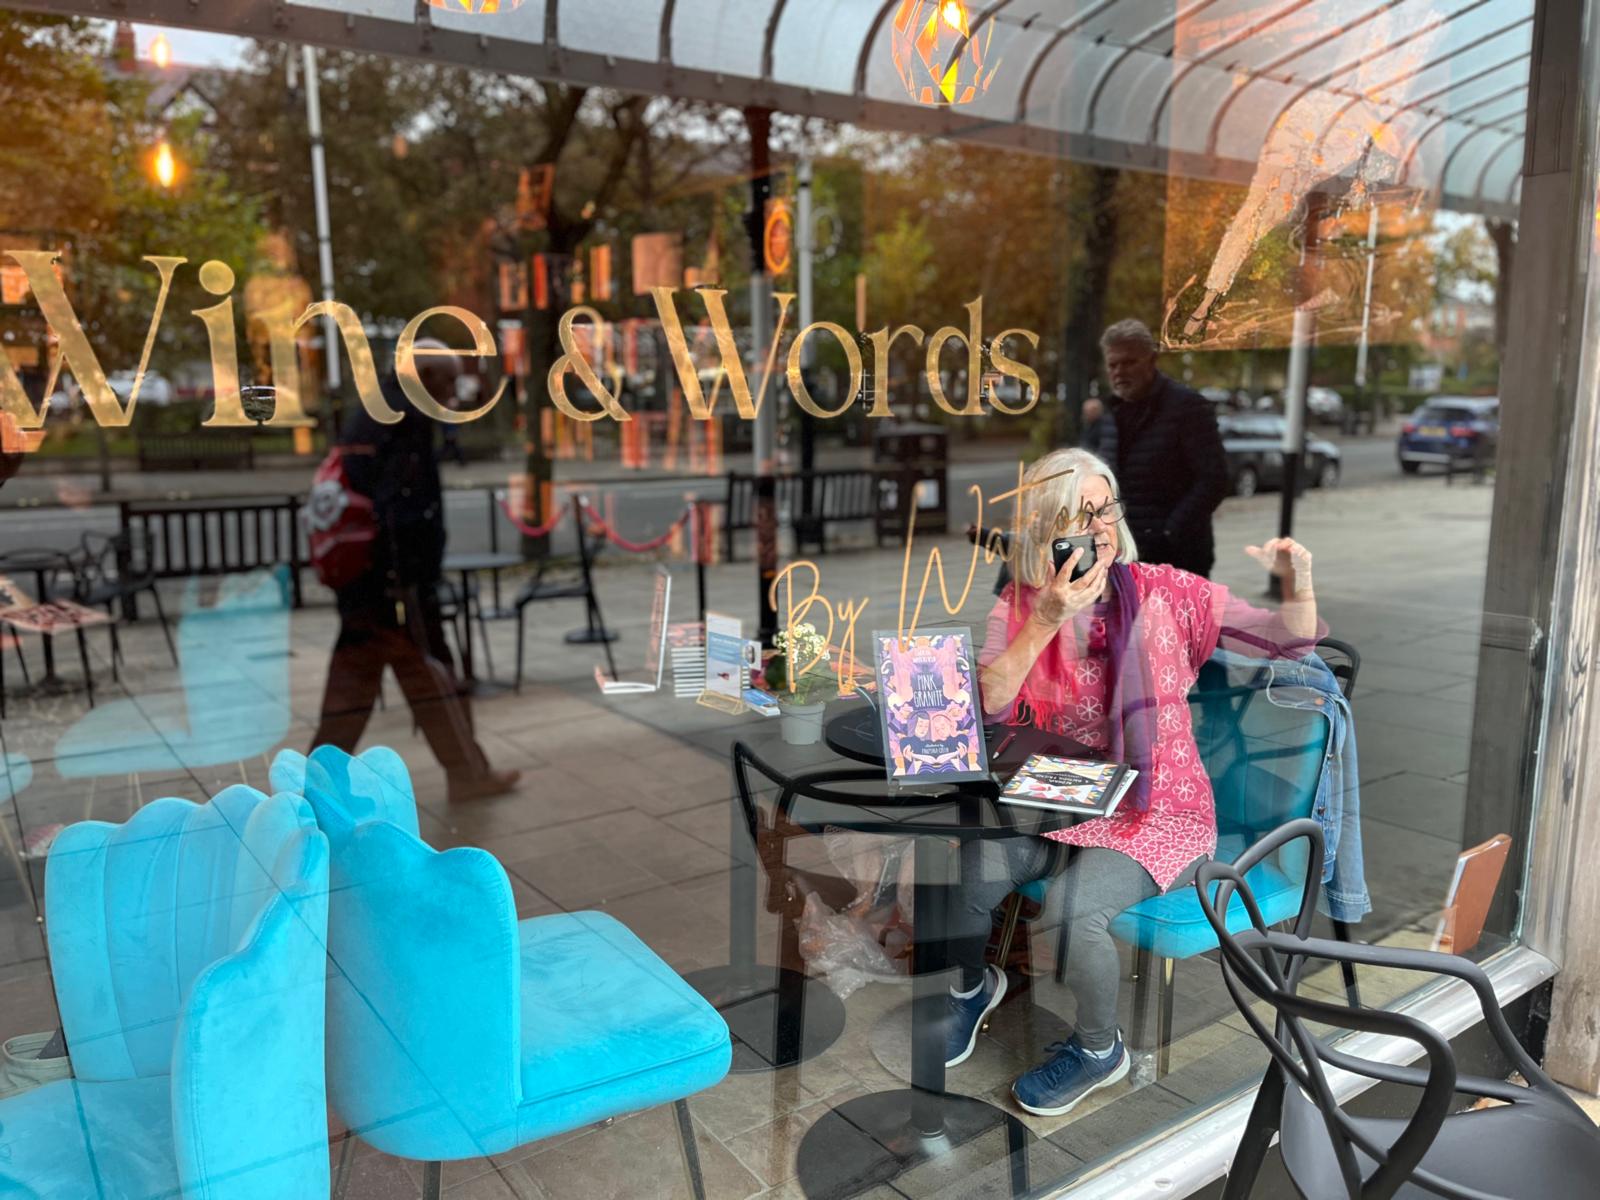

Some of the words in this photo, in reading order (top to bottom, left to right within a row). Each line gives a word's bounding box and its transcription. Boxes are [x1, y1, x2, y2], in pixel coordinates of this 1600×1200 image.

[0, 251, 508, 427] Wine
[547, 306, 632, 421] &
[647, 286, 1041, 420] Words
[769, 560, 869, 693] By
[913, 690, 945, 708] GRANITE
[917, 674, 937, 690] PINK
